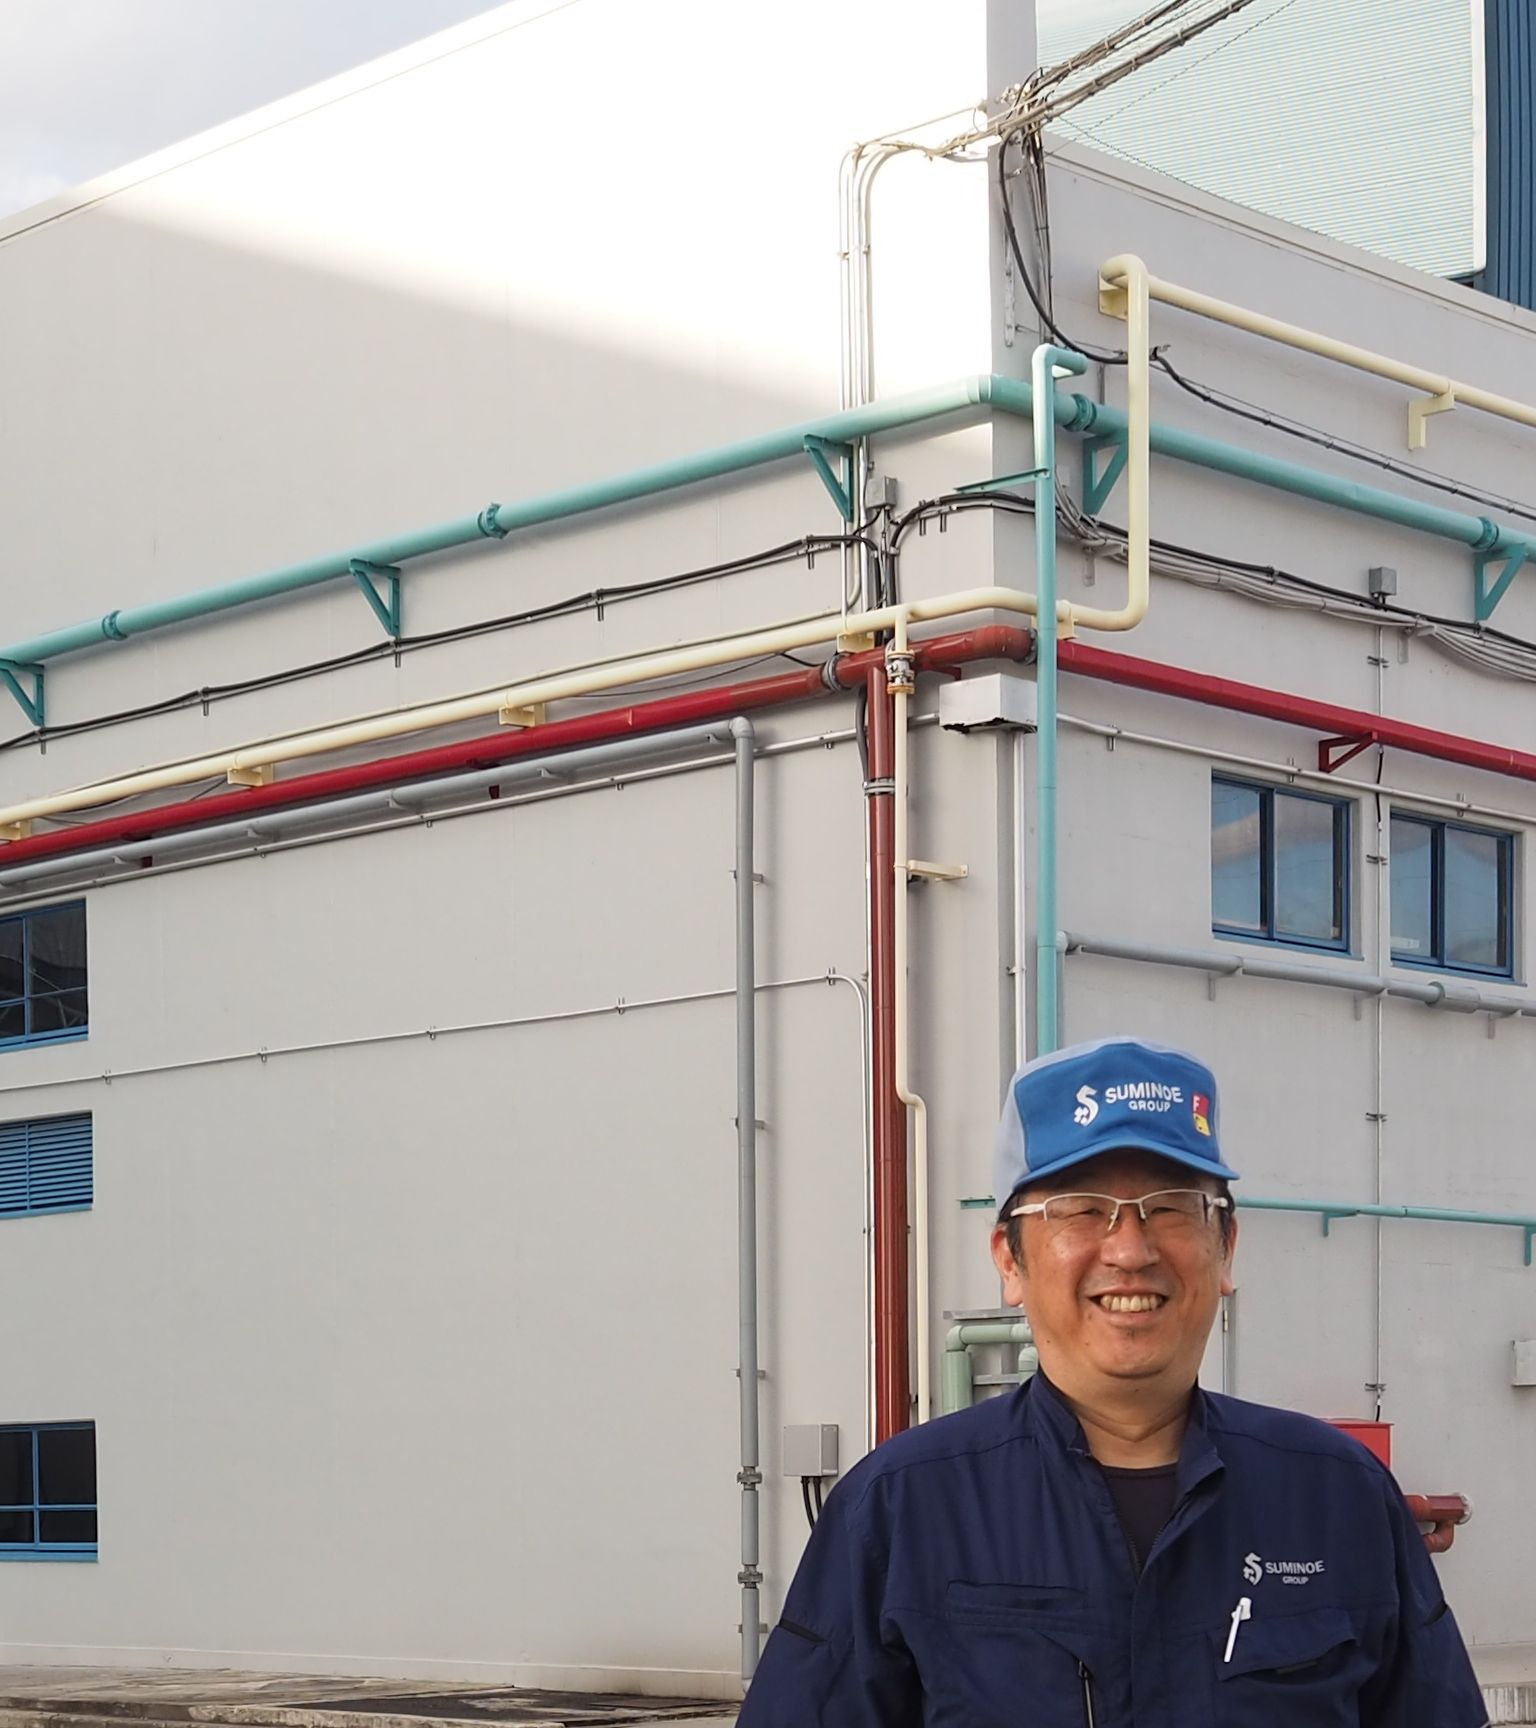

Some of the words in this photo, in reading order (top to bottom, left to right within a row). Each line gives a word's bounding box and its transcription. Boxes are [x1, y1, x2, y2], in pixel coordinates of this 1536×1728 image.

[1105, 1081, 1184, 1104] SUMINOE
[1129, 1100, 1171, 1112] GROUP
[1265, 1560, 1325, 1574] SUMINOE
[1282, 1576, 1309, 1584] GROUP
